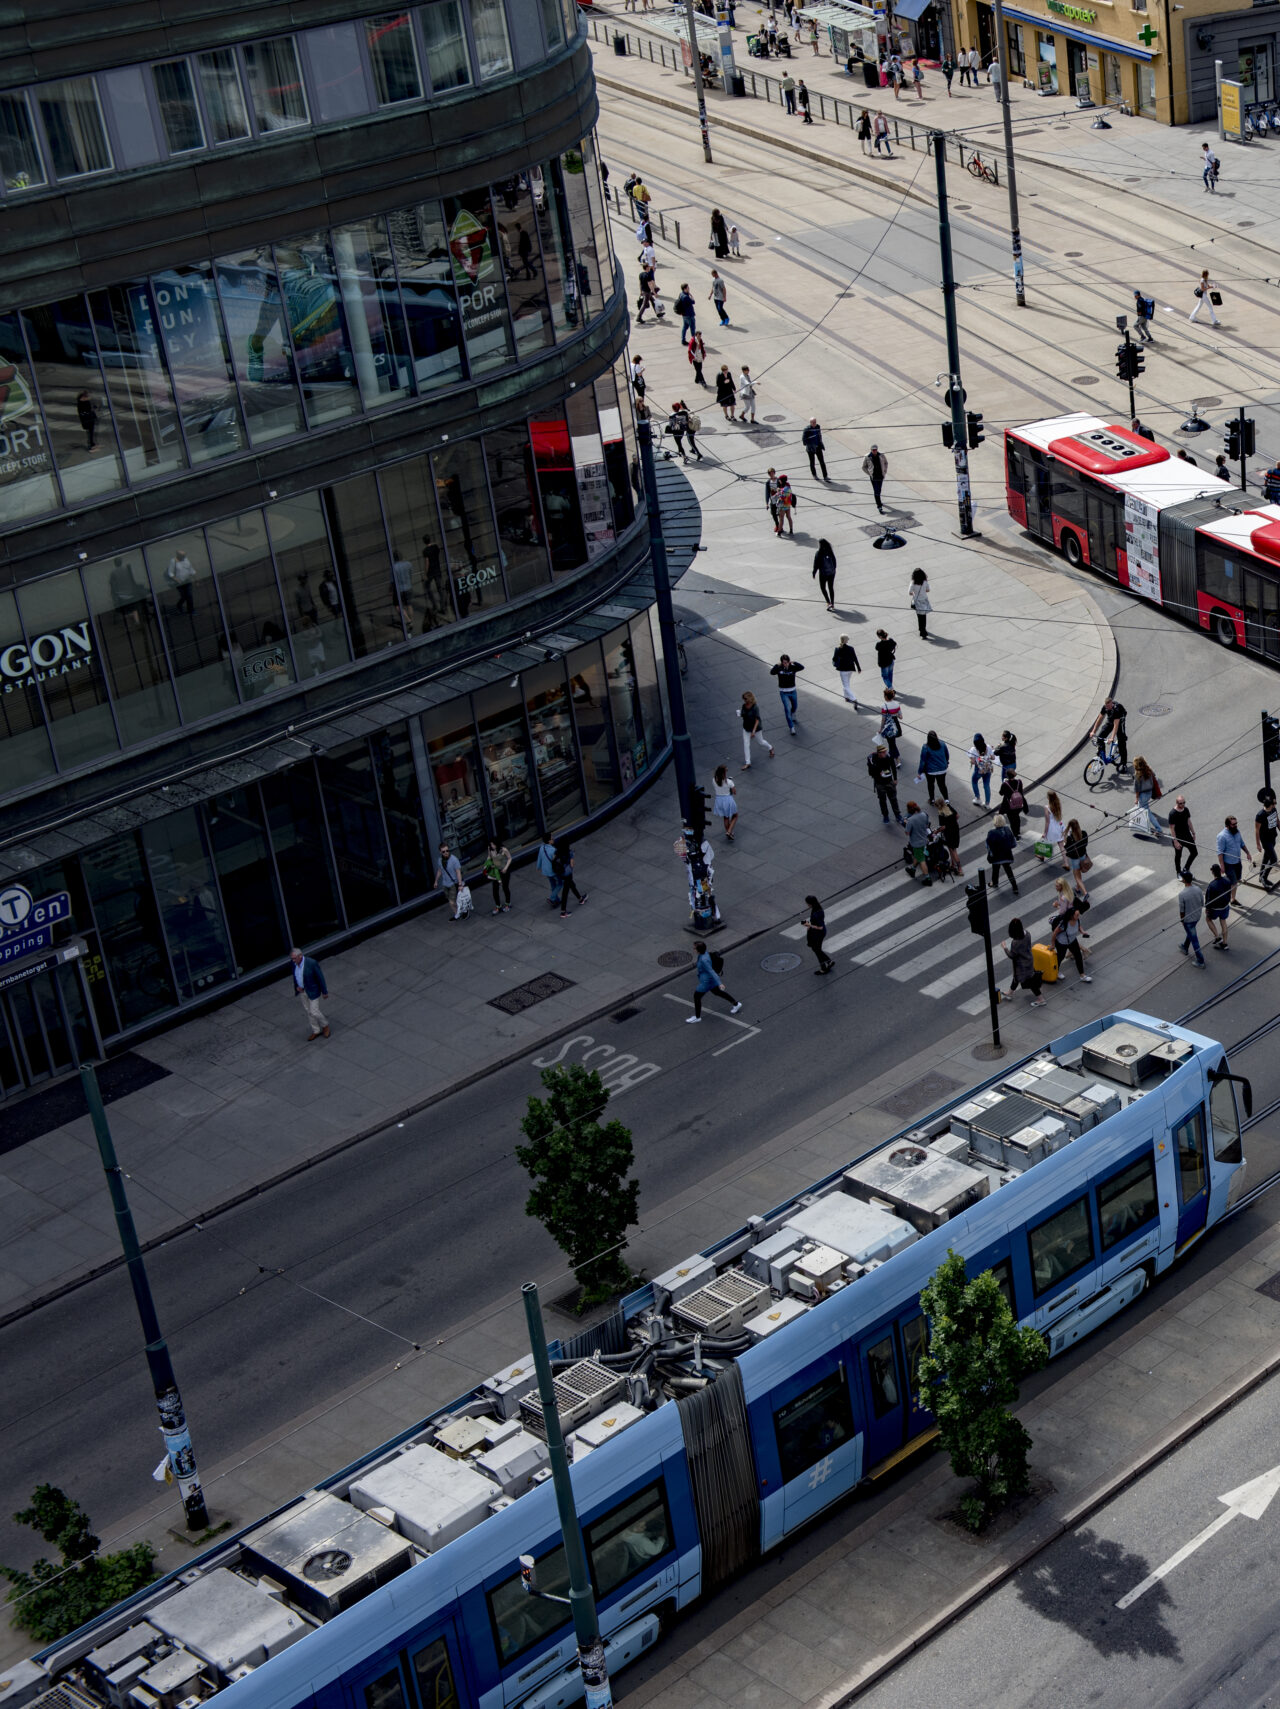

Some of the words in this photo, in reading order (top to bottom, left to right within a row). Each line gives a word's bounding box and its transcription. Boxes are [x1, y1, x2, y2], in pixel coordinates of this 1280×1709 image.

[22, 453, 48, 469] STORE
[457, 565, 497, 590] EGON
[0, 622, 92, 682] GON
[243, 651, 285, 678] EGON
[0, 656, 92, 696] STAURANT
[2, 895, 20, 919] T
[0, 934, 44, 961] pping
